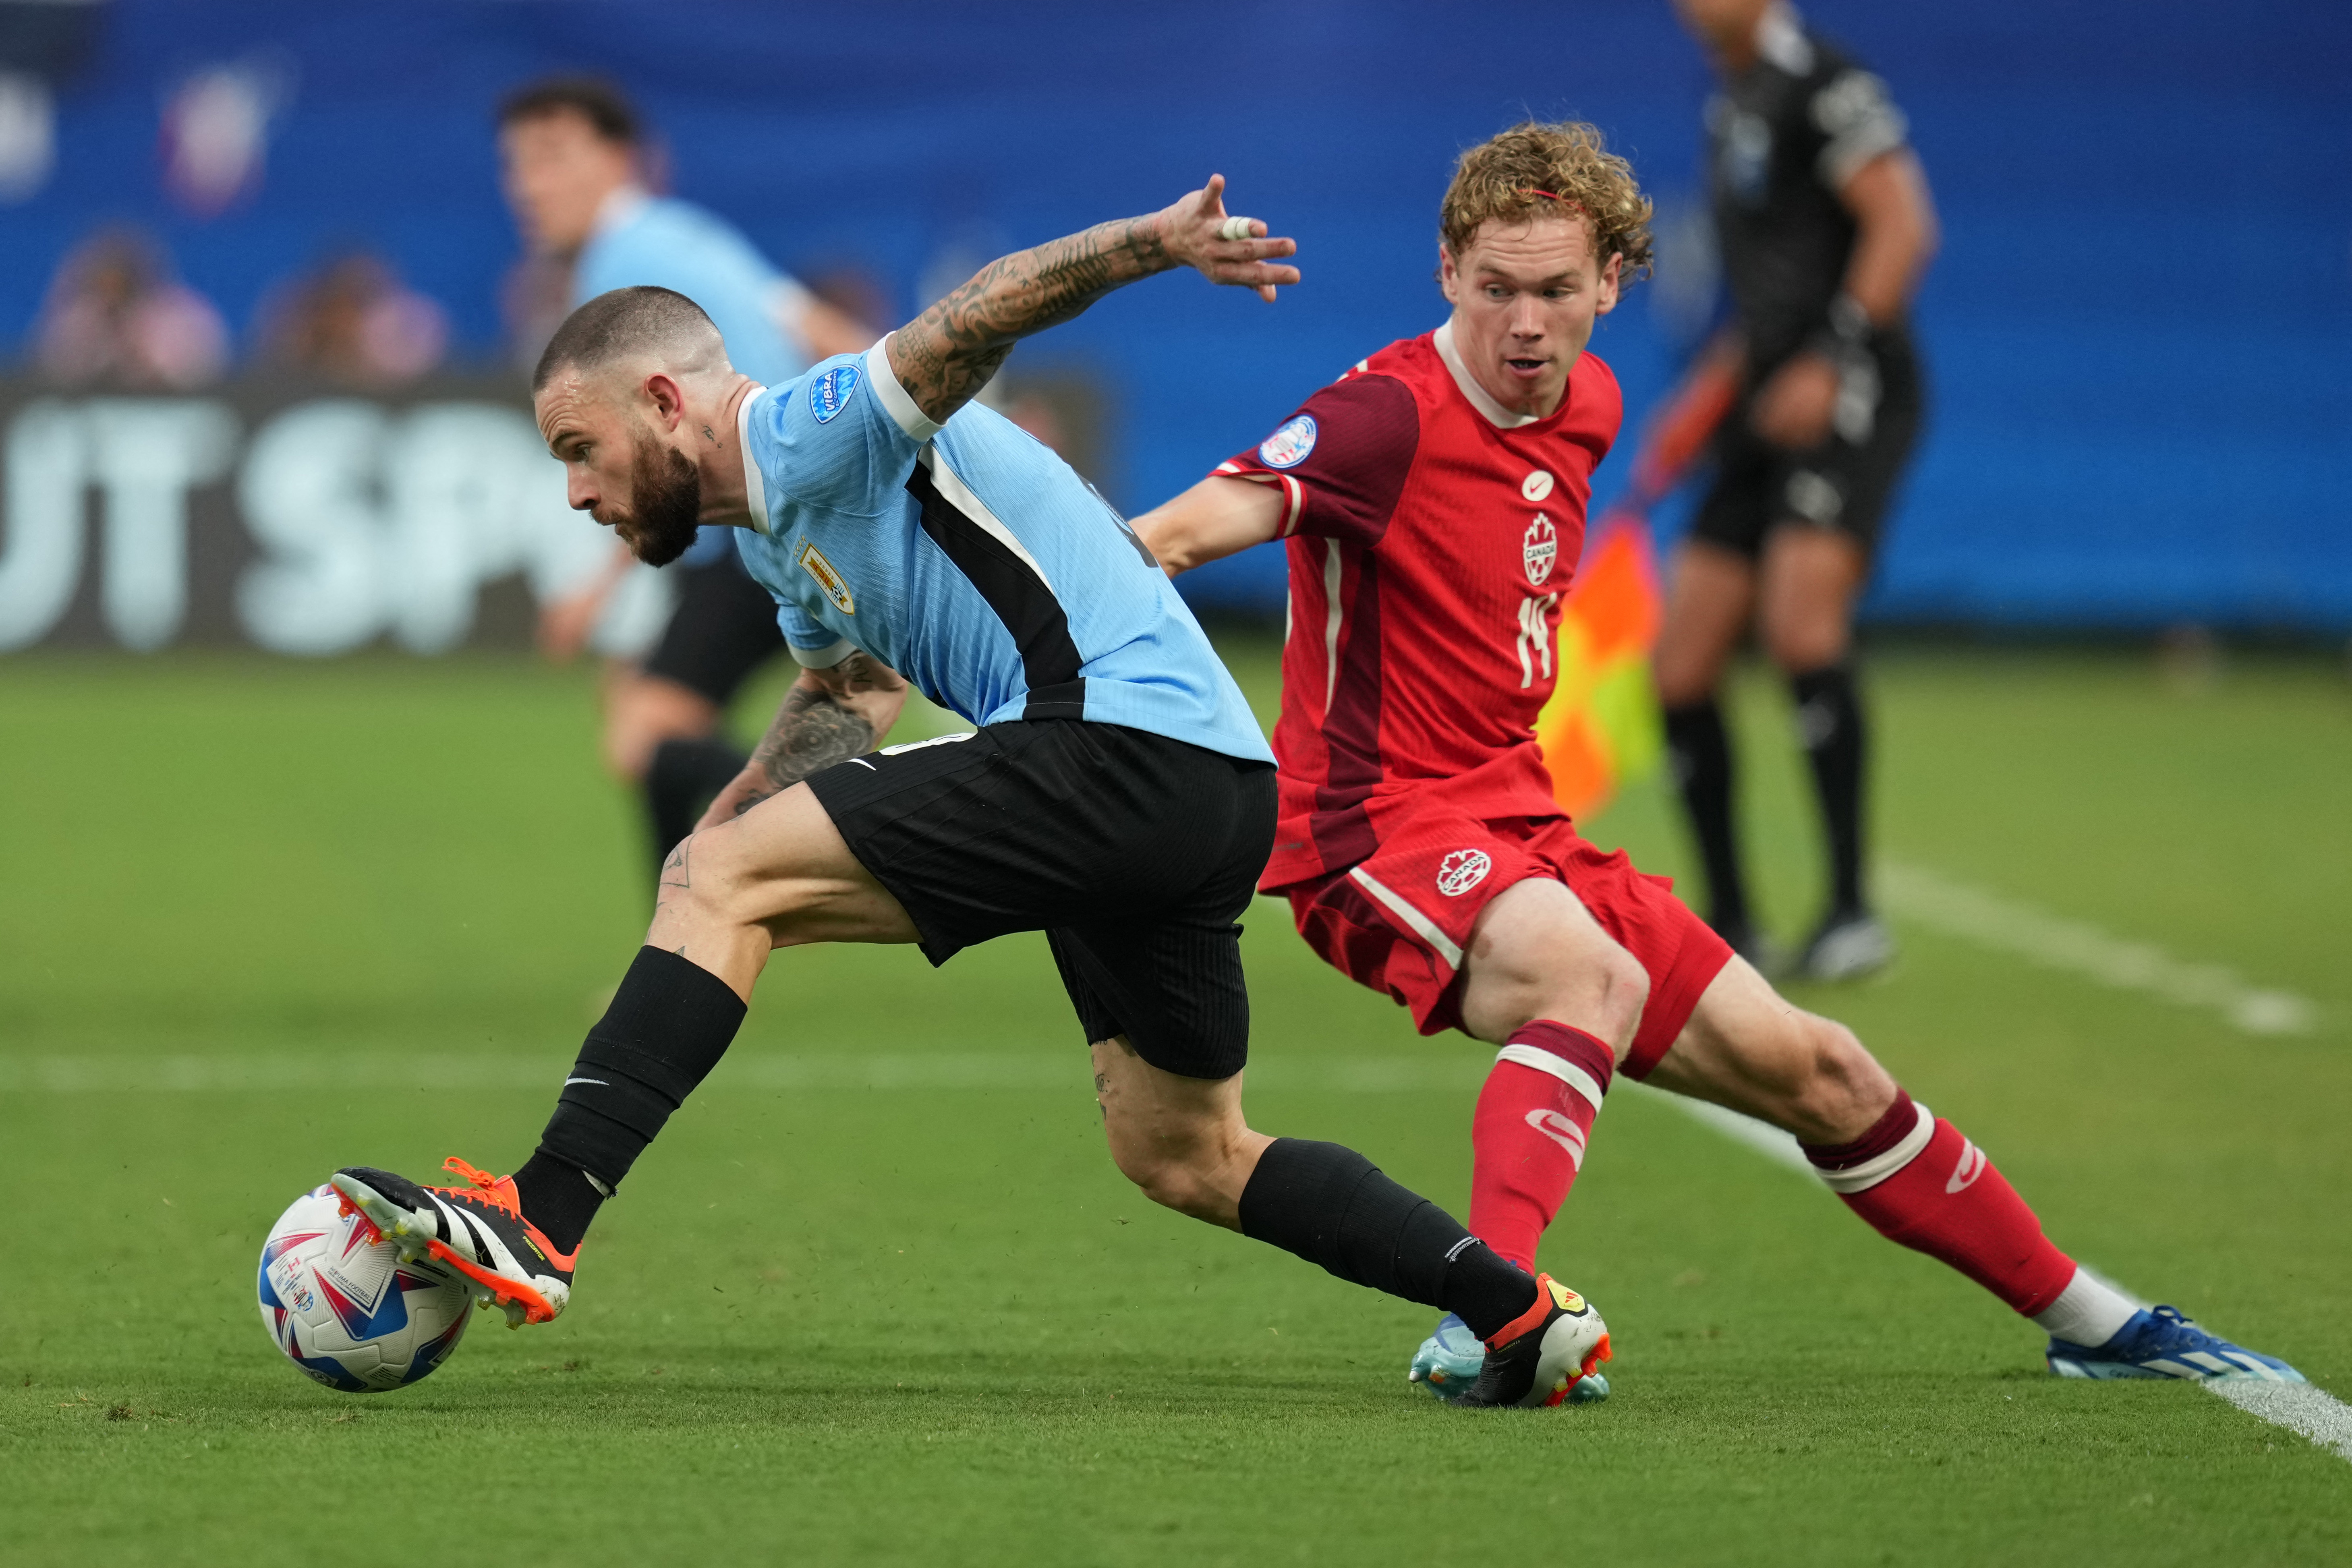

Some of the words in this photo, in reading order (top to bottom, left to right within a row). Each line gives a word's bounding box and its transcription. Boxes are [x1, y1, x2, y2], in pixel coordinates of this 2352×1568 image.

[823, 372, 835, 411] VIBRA
[1526, 544, 1554, 559] CANADA
[812, 563, 830, 586] AUF
[1443, 856, 1485, 891] CANADA
[522, 1236, 545, 1261] PREDATOR
